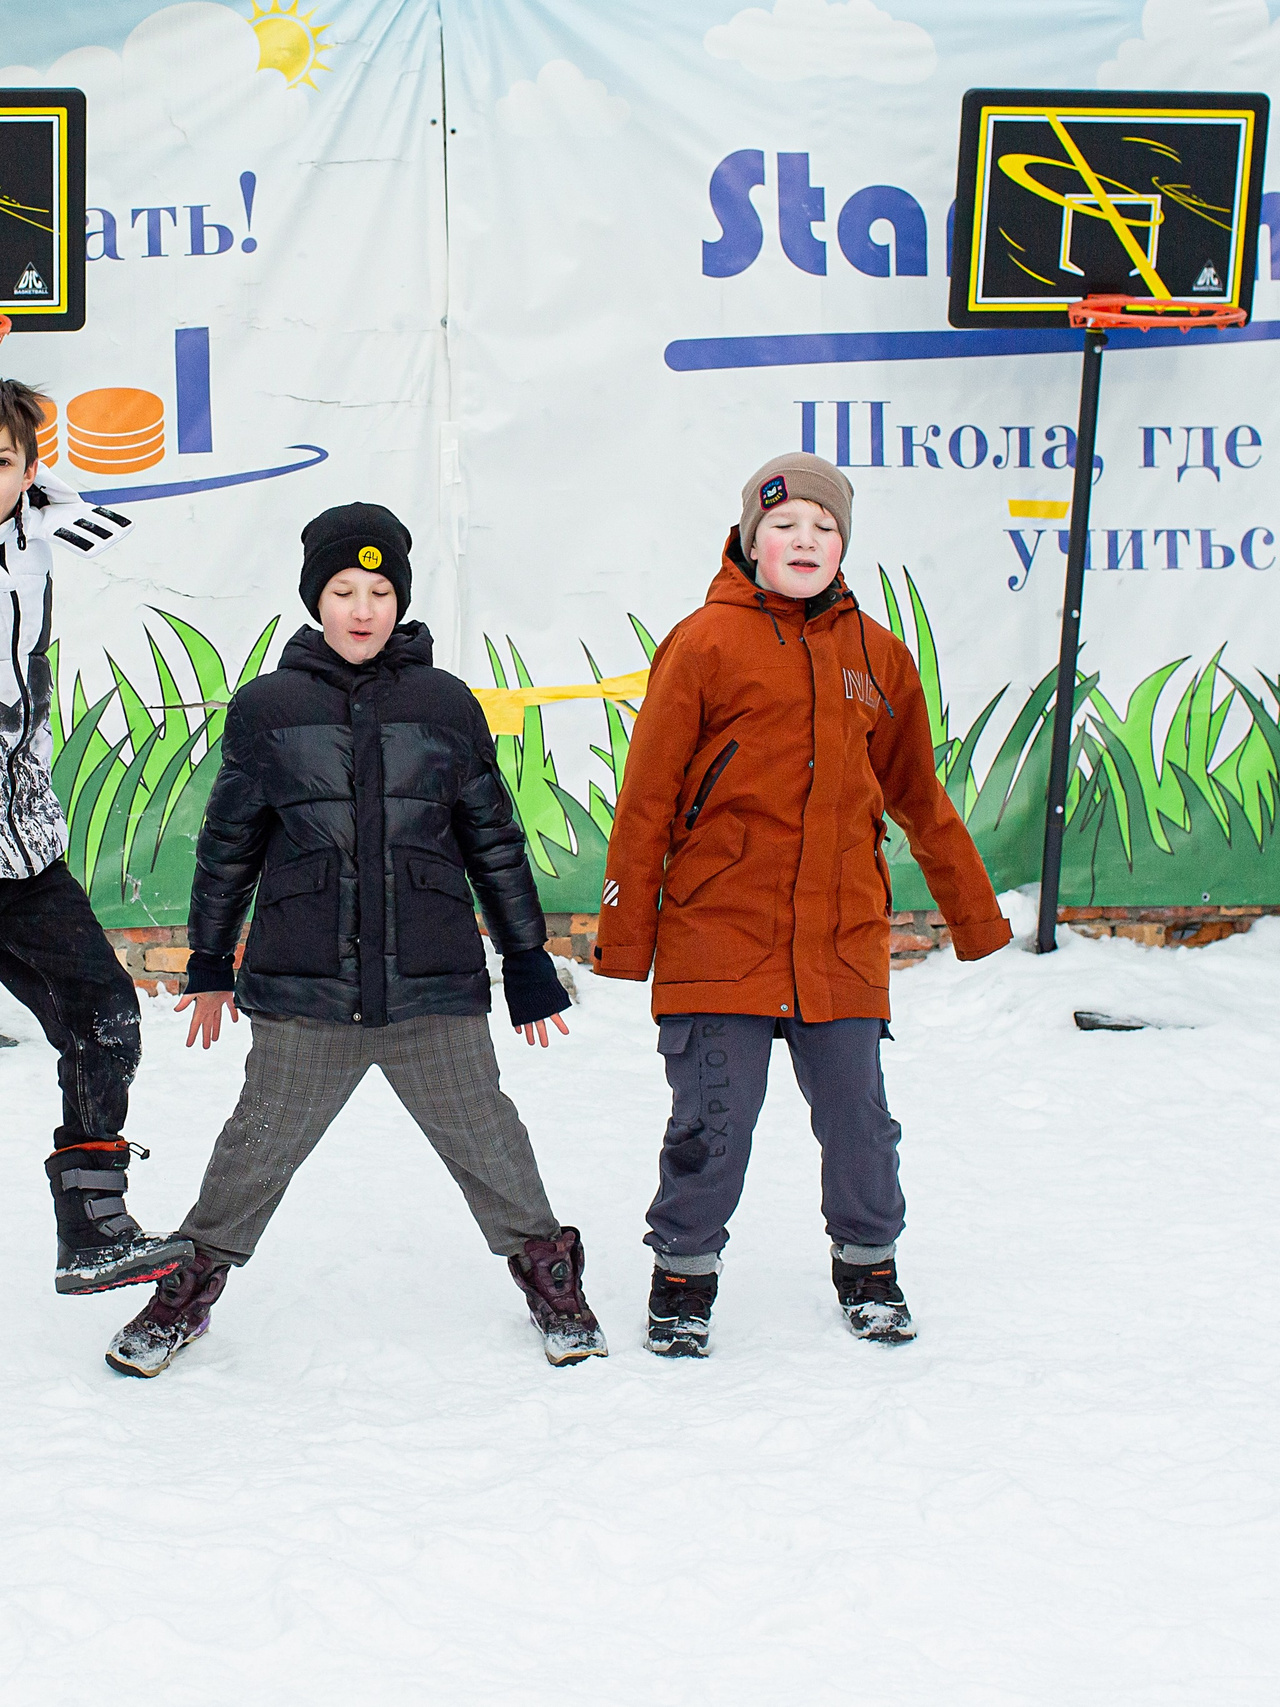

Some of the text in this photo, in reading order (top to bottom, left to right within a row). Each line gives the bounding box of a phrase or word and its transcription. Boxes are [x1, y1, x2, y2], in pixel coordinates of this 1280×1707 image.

[793, 401, 1263, 486] Школа, где
[362, 550, 378, 564] A4
[1002, 526, 1276, 592] учитьс
